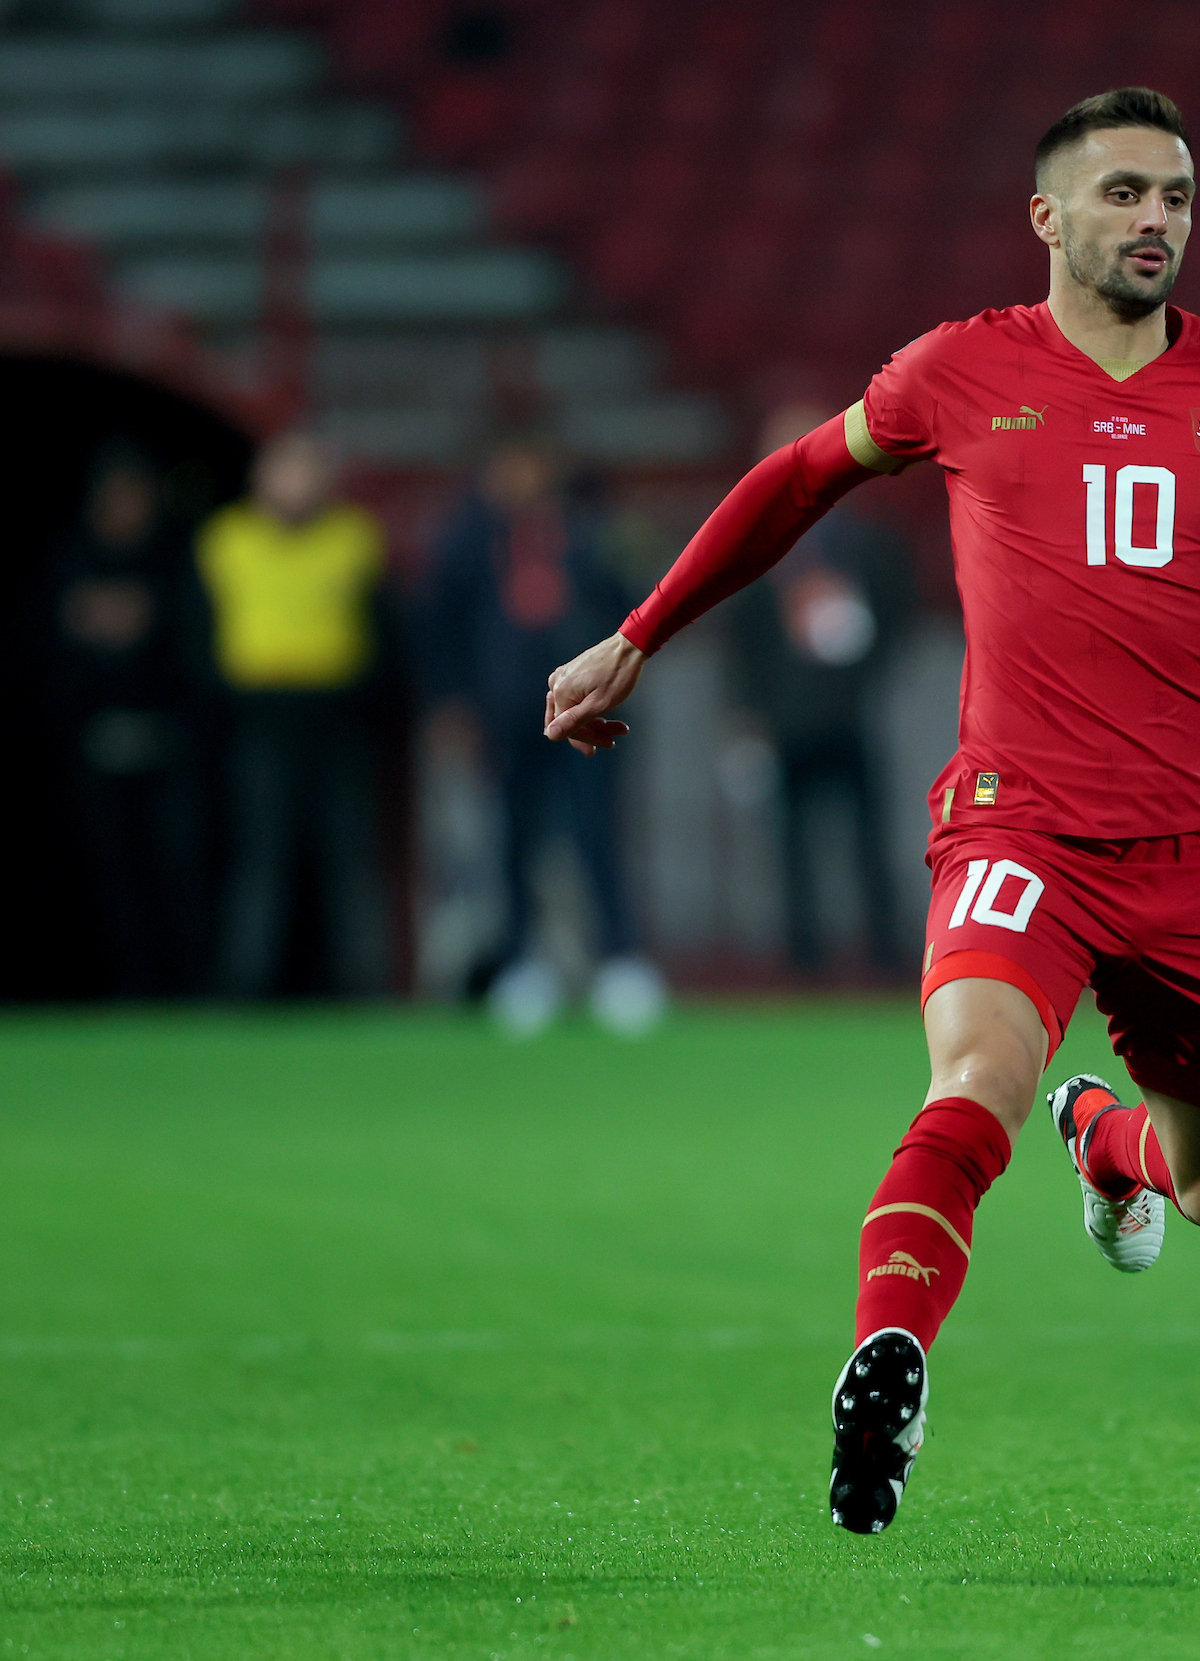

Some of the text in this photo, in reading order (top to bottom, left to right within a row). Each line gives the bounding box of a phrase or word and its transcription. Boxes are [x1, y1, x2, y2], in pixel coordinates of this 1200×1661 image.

[991, 416, 1037, 431] PUMA
[1093, 420, 1115, 434] SRB
[1122, 422, 1147, 436] MNE
[1082, 463, 1176, 568] 10
[948, 858, 1046, 933] 10
[866, 1263, 920, 1282] PUMA
